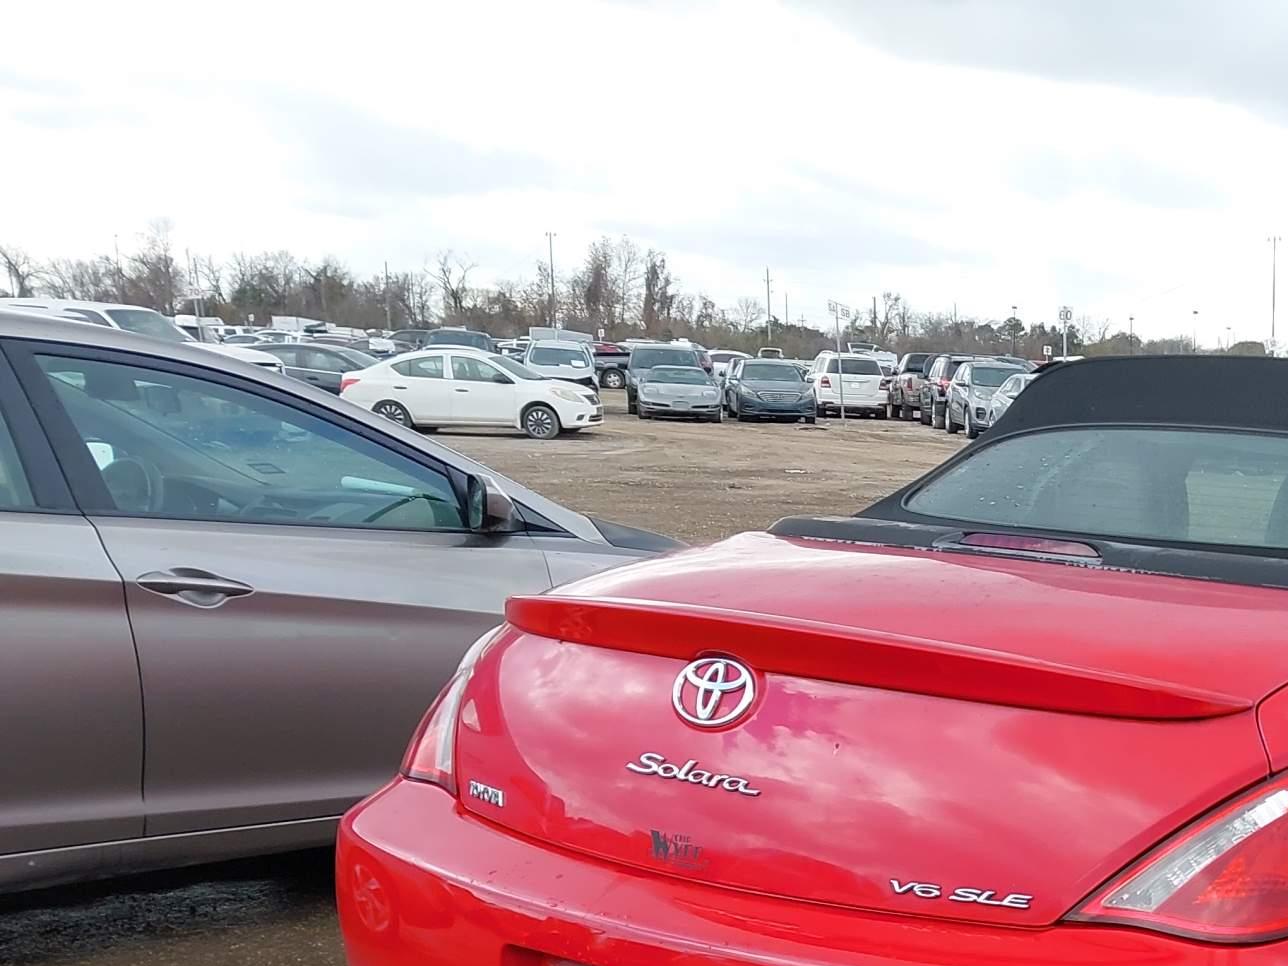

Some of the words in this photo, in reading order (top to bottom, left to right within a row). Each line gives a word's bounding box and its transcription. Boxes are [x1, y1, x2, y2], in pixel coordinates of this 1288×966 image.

[625, 752, 761, 796] Solara
[889, 878, 942, 898] V6
[948, 887, 1034, 909] SLE
